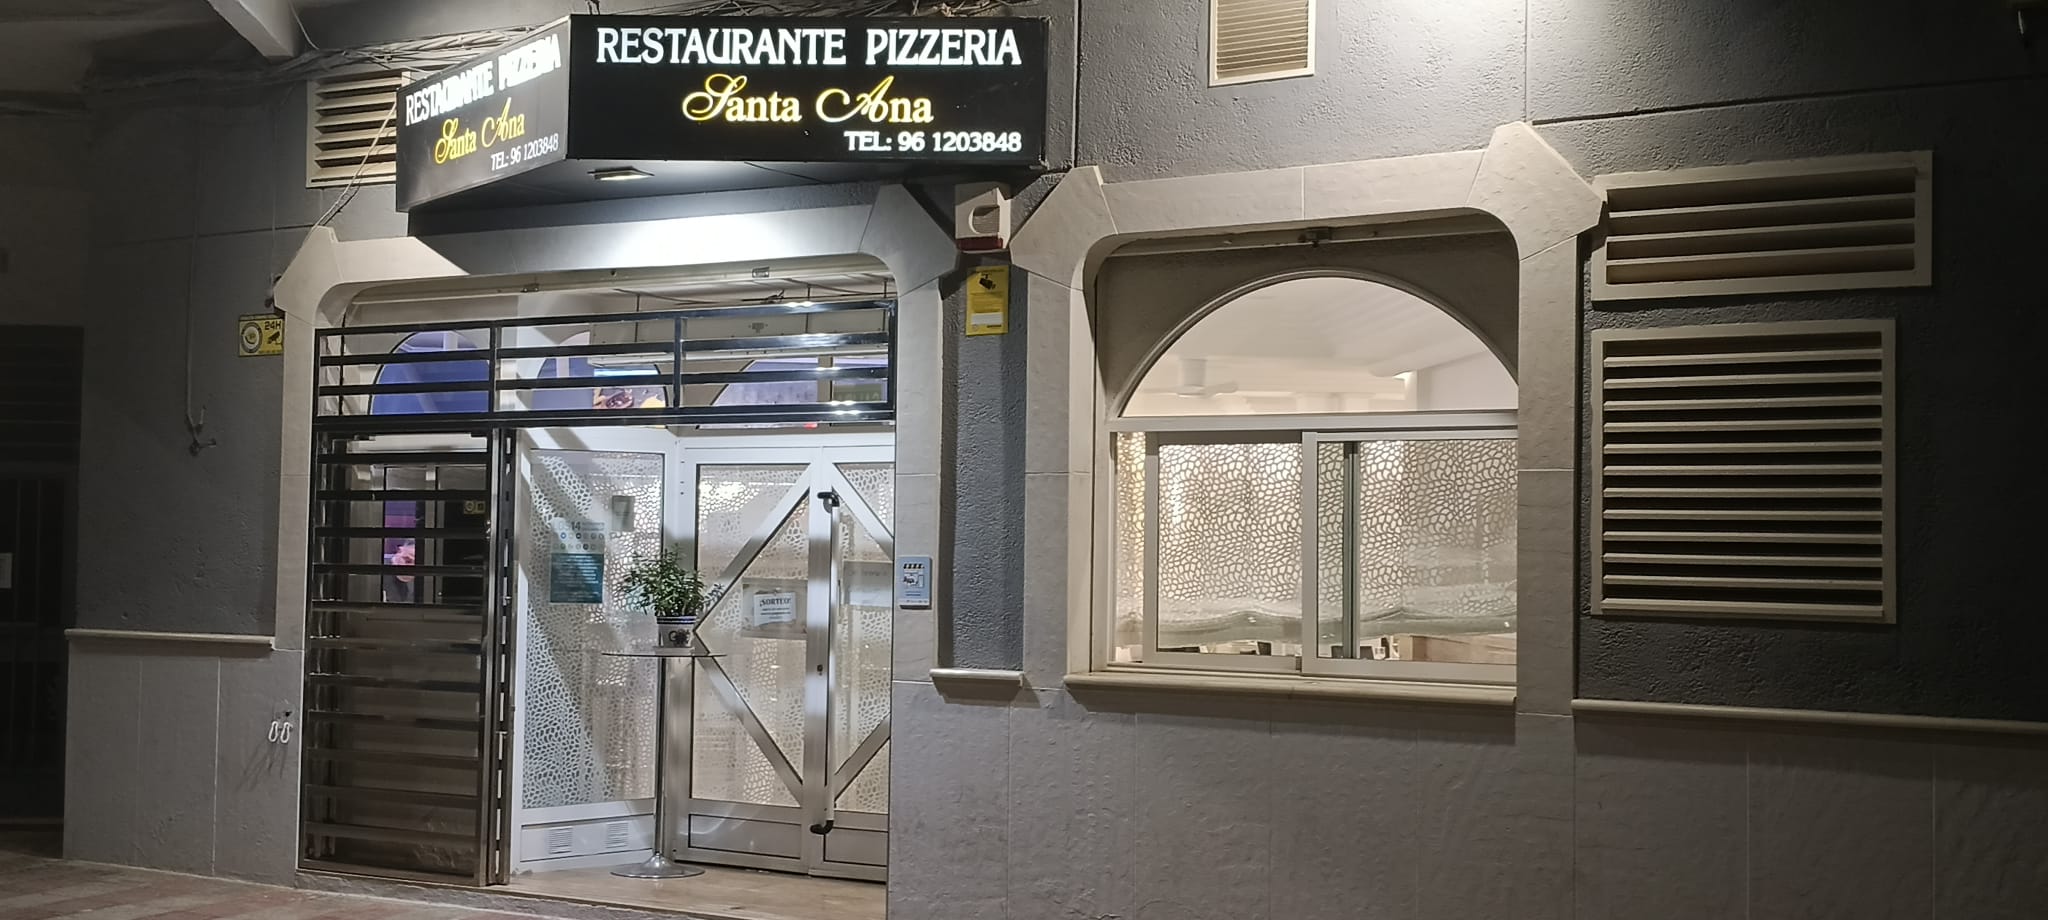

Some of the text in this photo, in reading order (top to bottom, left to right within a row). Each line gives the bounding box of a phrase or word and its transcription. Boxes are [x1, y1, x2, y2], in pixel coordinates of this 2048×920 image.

[596, 27, 1023, 65] RESTAURANTE PIZZERIA
[682, 73, 934, 123] Santa Ana
[434, 96, 525, 165] Santa Ana
[843, 131, 1023, 152] TEL: 96 1203848
[490, 132, 560, 171] TEL: 96 1203848
[264, 320, 282, 331] 24H
